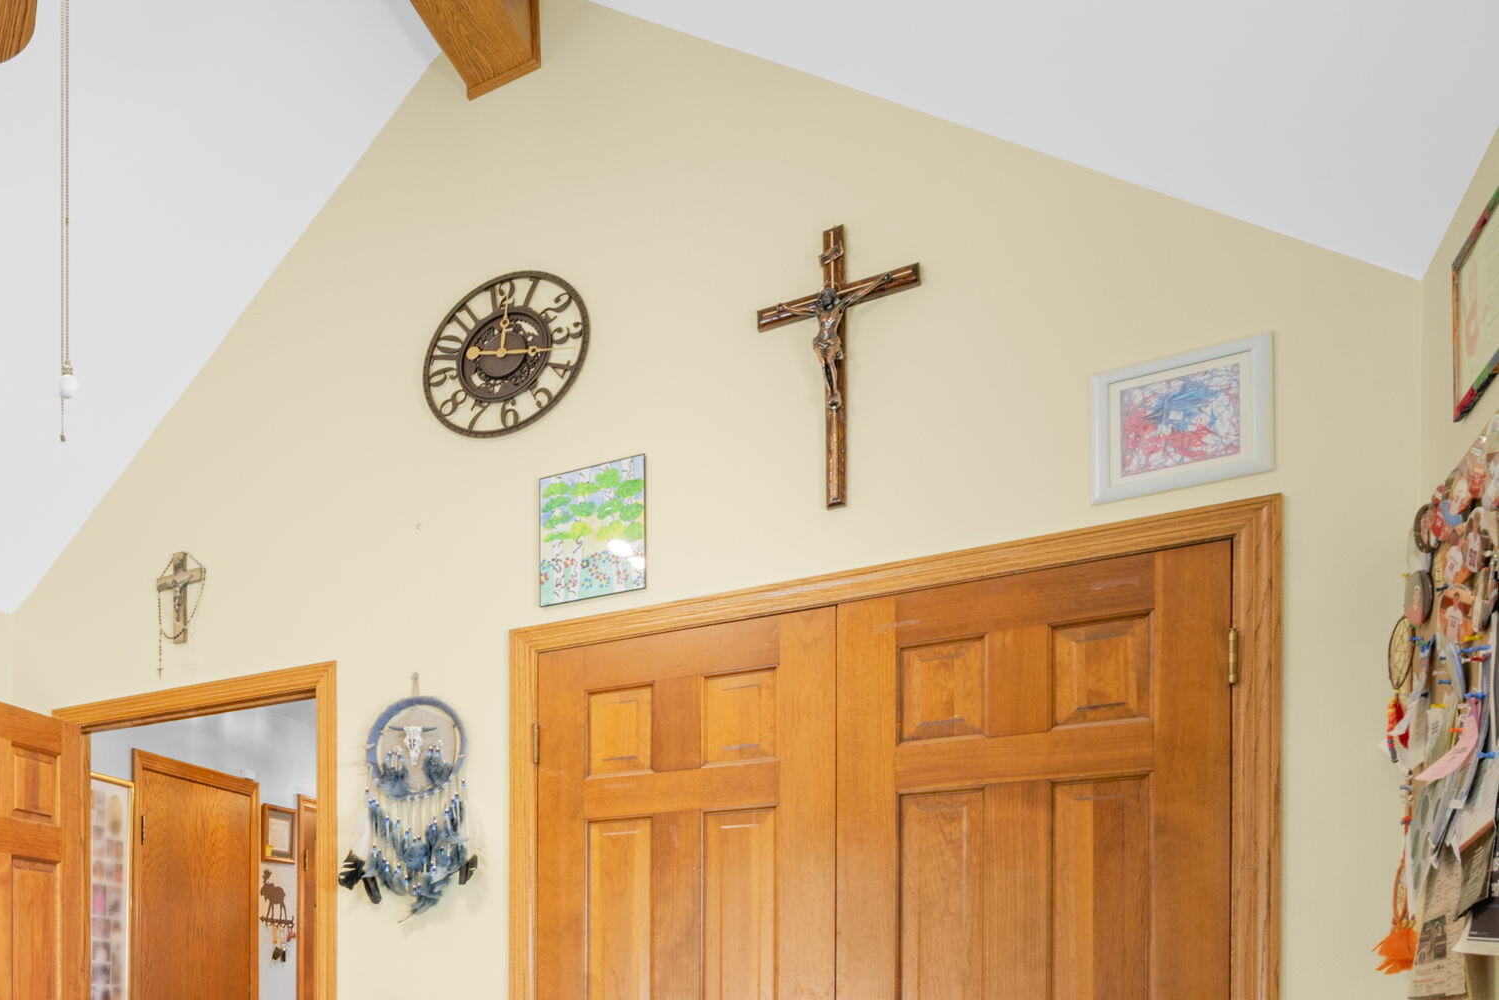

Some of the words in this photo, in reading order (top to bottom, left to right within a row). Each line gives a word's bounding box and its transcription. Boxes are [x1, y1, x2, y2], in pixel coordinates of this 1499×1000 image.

[485, 279, 516, 313] 12
[522, 276, 541, 308] 1
[538, 292, 573, 324] 2
[446, 302, 480, 336] 11
[551, 321, 583, 345] 3
[429, 334, 464, 367] 10
[428, 366, 458, 388] 9
[547, 359, 576, 380] 4
[439, 388, 469, 418] 8
[530, 380, 553, 409] 5
[467, 399, 492, 432] 7
[501, 396, 519, 429] 6
